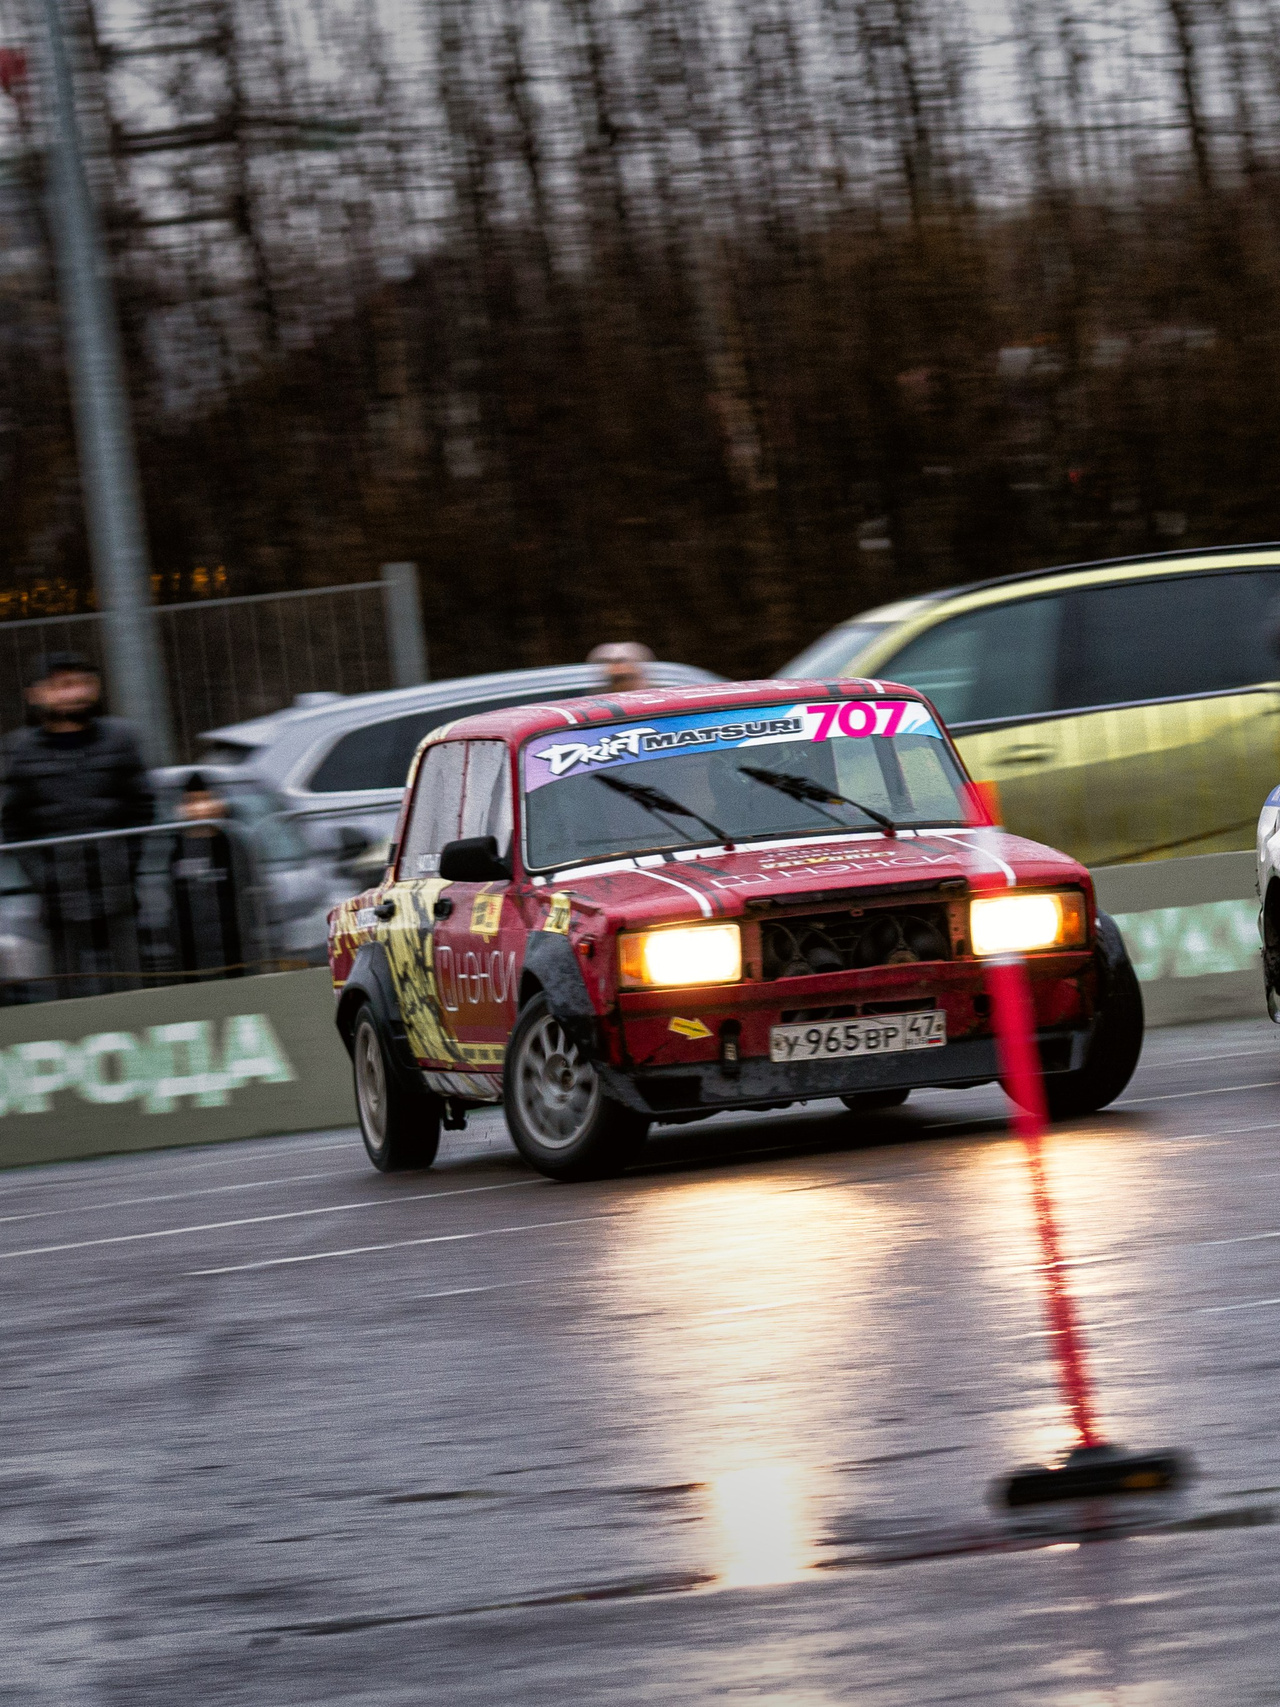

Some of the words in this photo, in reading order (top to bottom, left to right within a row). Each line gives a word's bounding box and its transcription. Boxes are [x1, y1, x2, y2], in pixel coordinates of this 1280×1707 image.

[643, 716, 804, 752] MATSURI
[805, 700, 908, 743] 707
[777, 853, 957, 879] НЭНСИ
[908, 1016, 936, 1037] 47
[905, 1036, 928, 1046] RUS
[0, 1013, 298, 1116] РОДА
